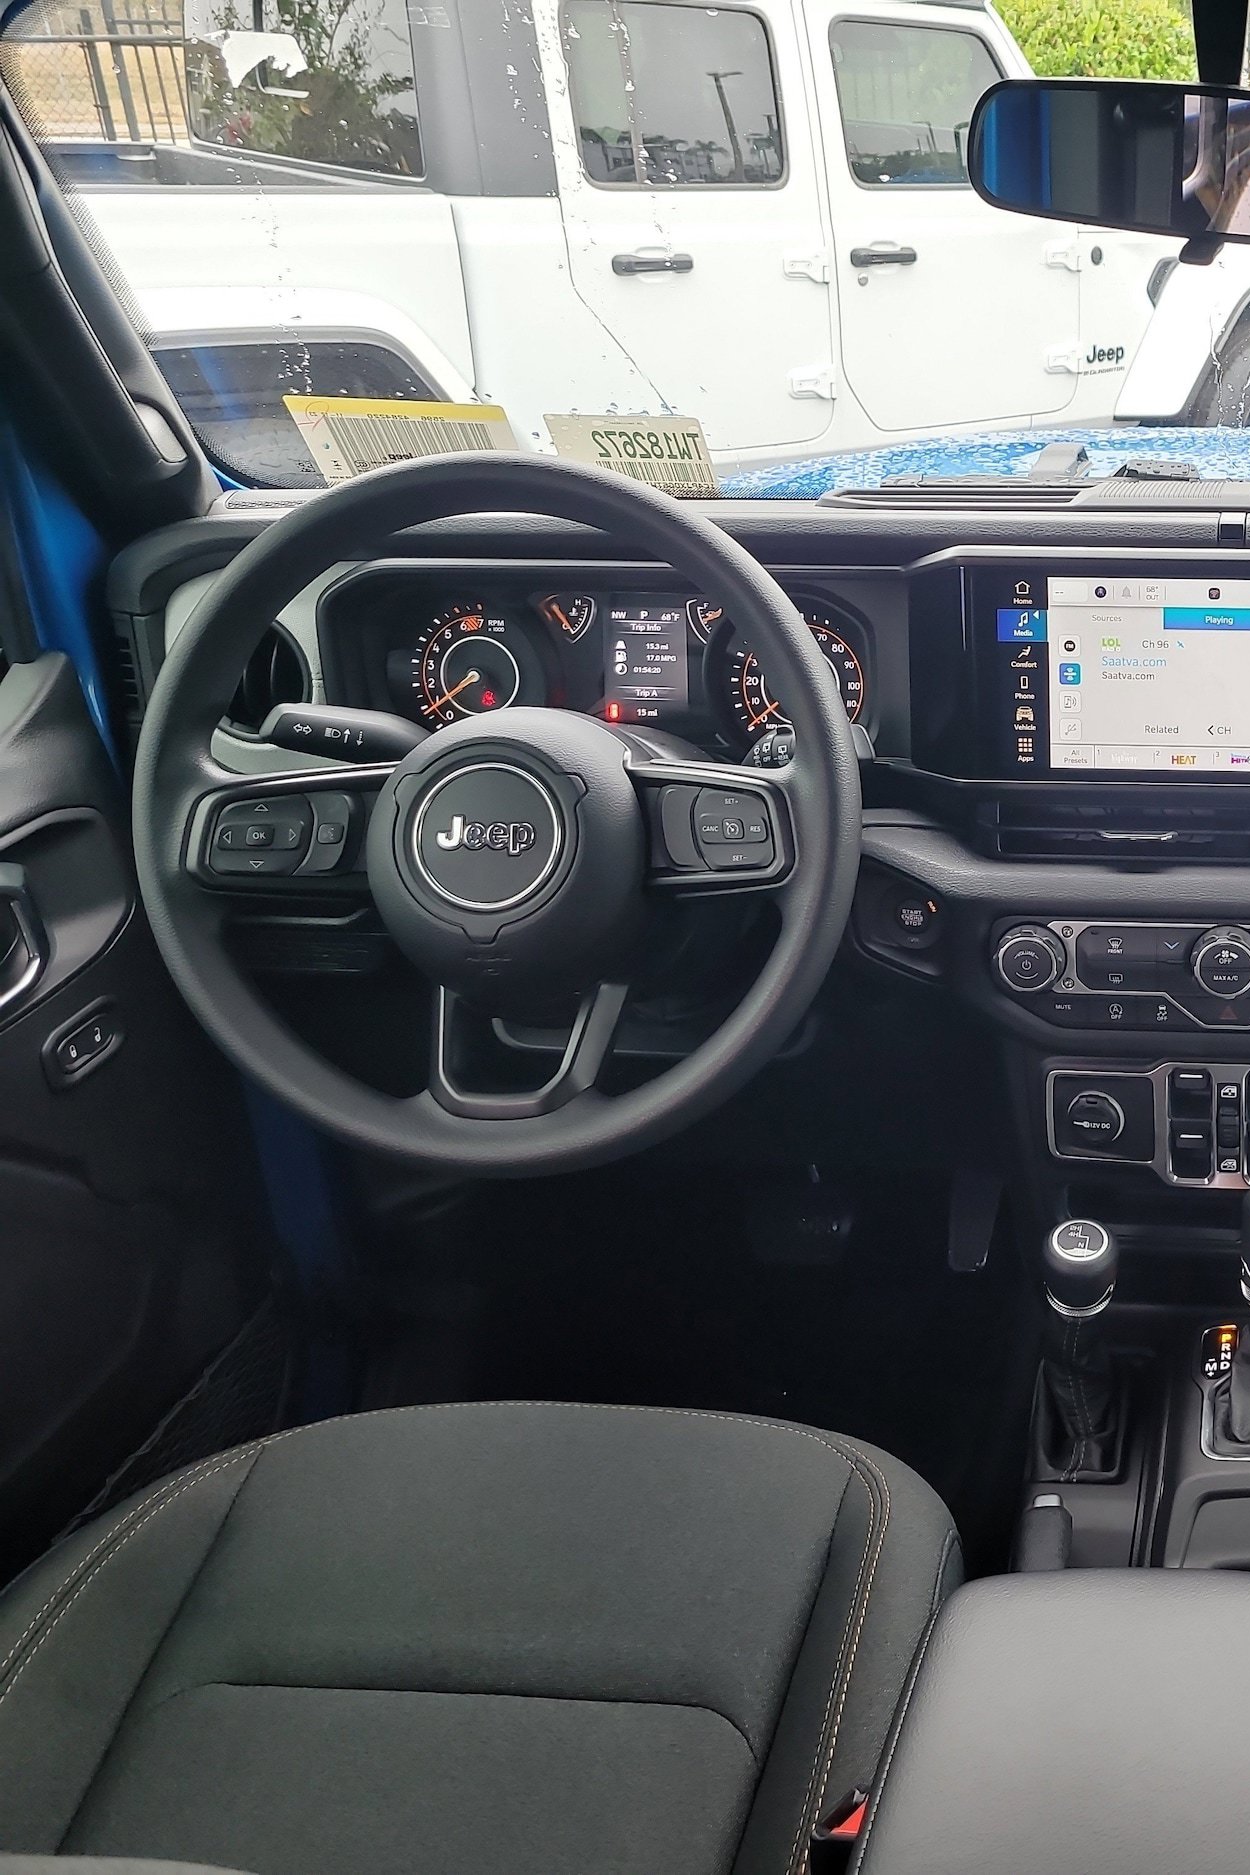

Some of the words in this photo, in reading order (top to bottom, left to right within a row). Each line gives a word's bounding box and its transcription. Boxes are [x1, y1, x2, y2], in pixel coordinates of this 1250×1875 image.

[1087, 345, 1124, 364] Jeep
[611, 611, 626, 619] NW
[640, 611, 648, 619] P
[1092, 614, 1122, 622] Sources
[478, 619, 484, 628] 7
[1205, 616, 1233, 625] Playing
[460, 621, 466, 631] 6
[630, 623, 645, 632] Trip
[647, 623, 662, 632] Info
[444, 629, 452, 639] 5
[817, 633, 828, 641] 70
[1013, 629, 1033, 637] Media
[1101, 637, 1121, 647] LOL
[1142, 640, 1155, 649] Ch
[1157, 640, 1169, 649] 96
[433, 643, 440, 653] 4
[832, 644, 844, 653] 80
[427, 660, 435, 670] 3
[1101, 656, 1167, 667] Saatva.com
[1101, 671, 1155, 680] Saatva.com
[428, 678, 435, 688] 2
[746, 677, 759, 686] 20
[847, 682, 860, 690] 100
[635, 690, 650, 698] Trip
[751, 697, 760, 705] 10
[446, 711, 454, 720] 0
[1144, 725, 1179, 734] Related
[1217, 727, 1231, 735] CH
[1064, 757, 1088, 765] Presets
[1171, 755, 1197, 765] HEAT
[252, 831, 266, 840] OK
[436, 815, 536, 856] Jeep
[1221, 1333, 1232, 1343] P
[1221, 1343, 1231, 1351] R
[1220, 1351, 1231, 1360] N
[1205, 1362, 1218, 1371] M
[1220, 1361, 1231, 1370] D
